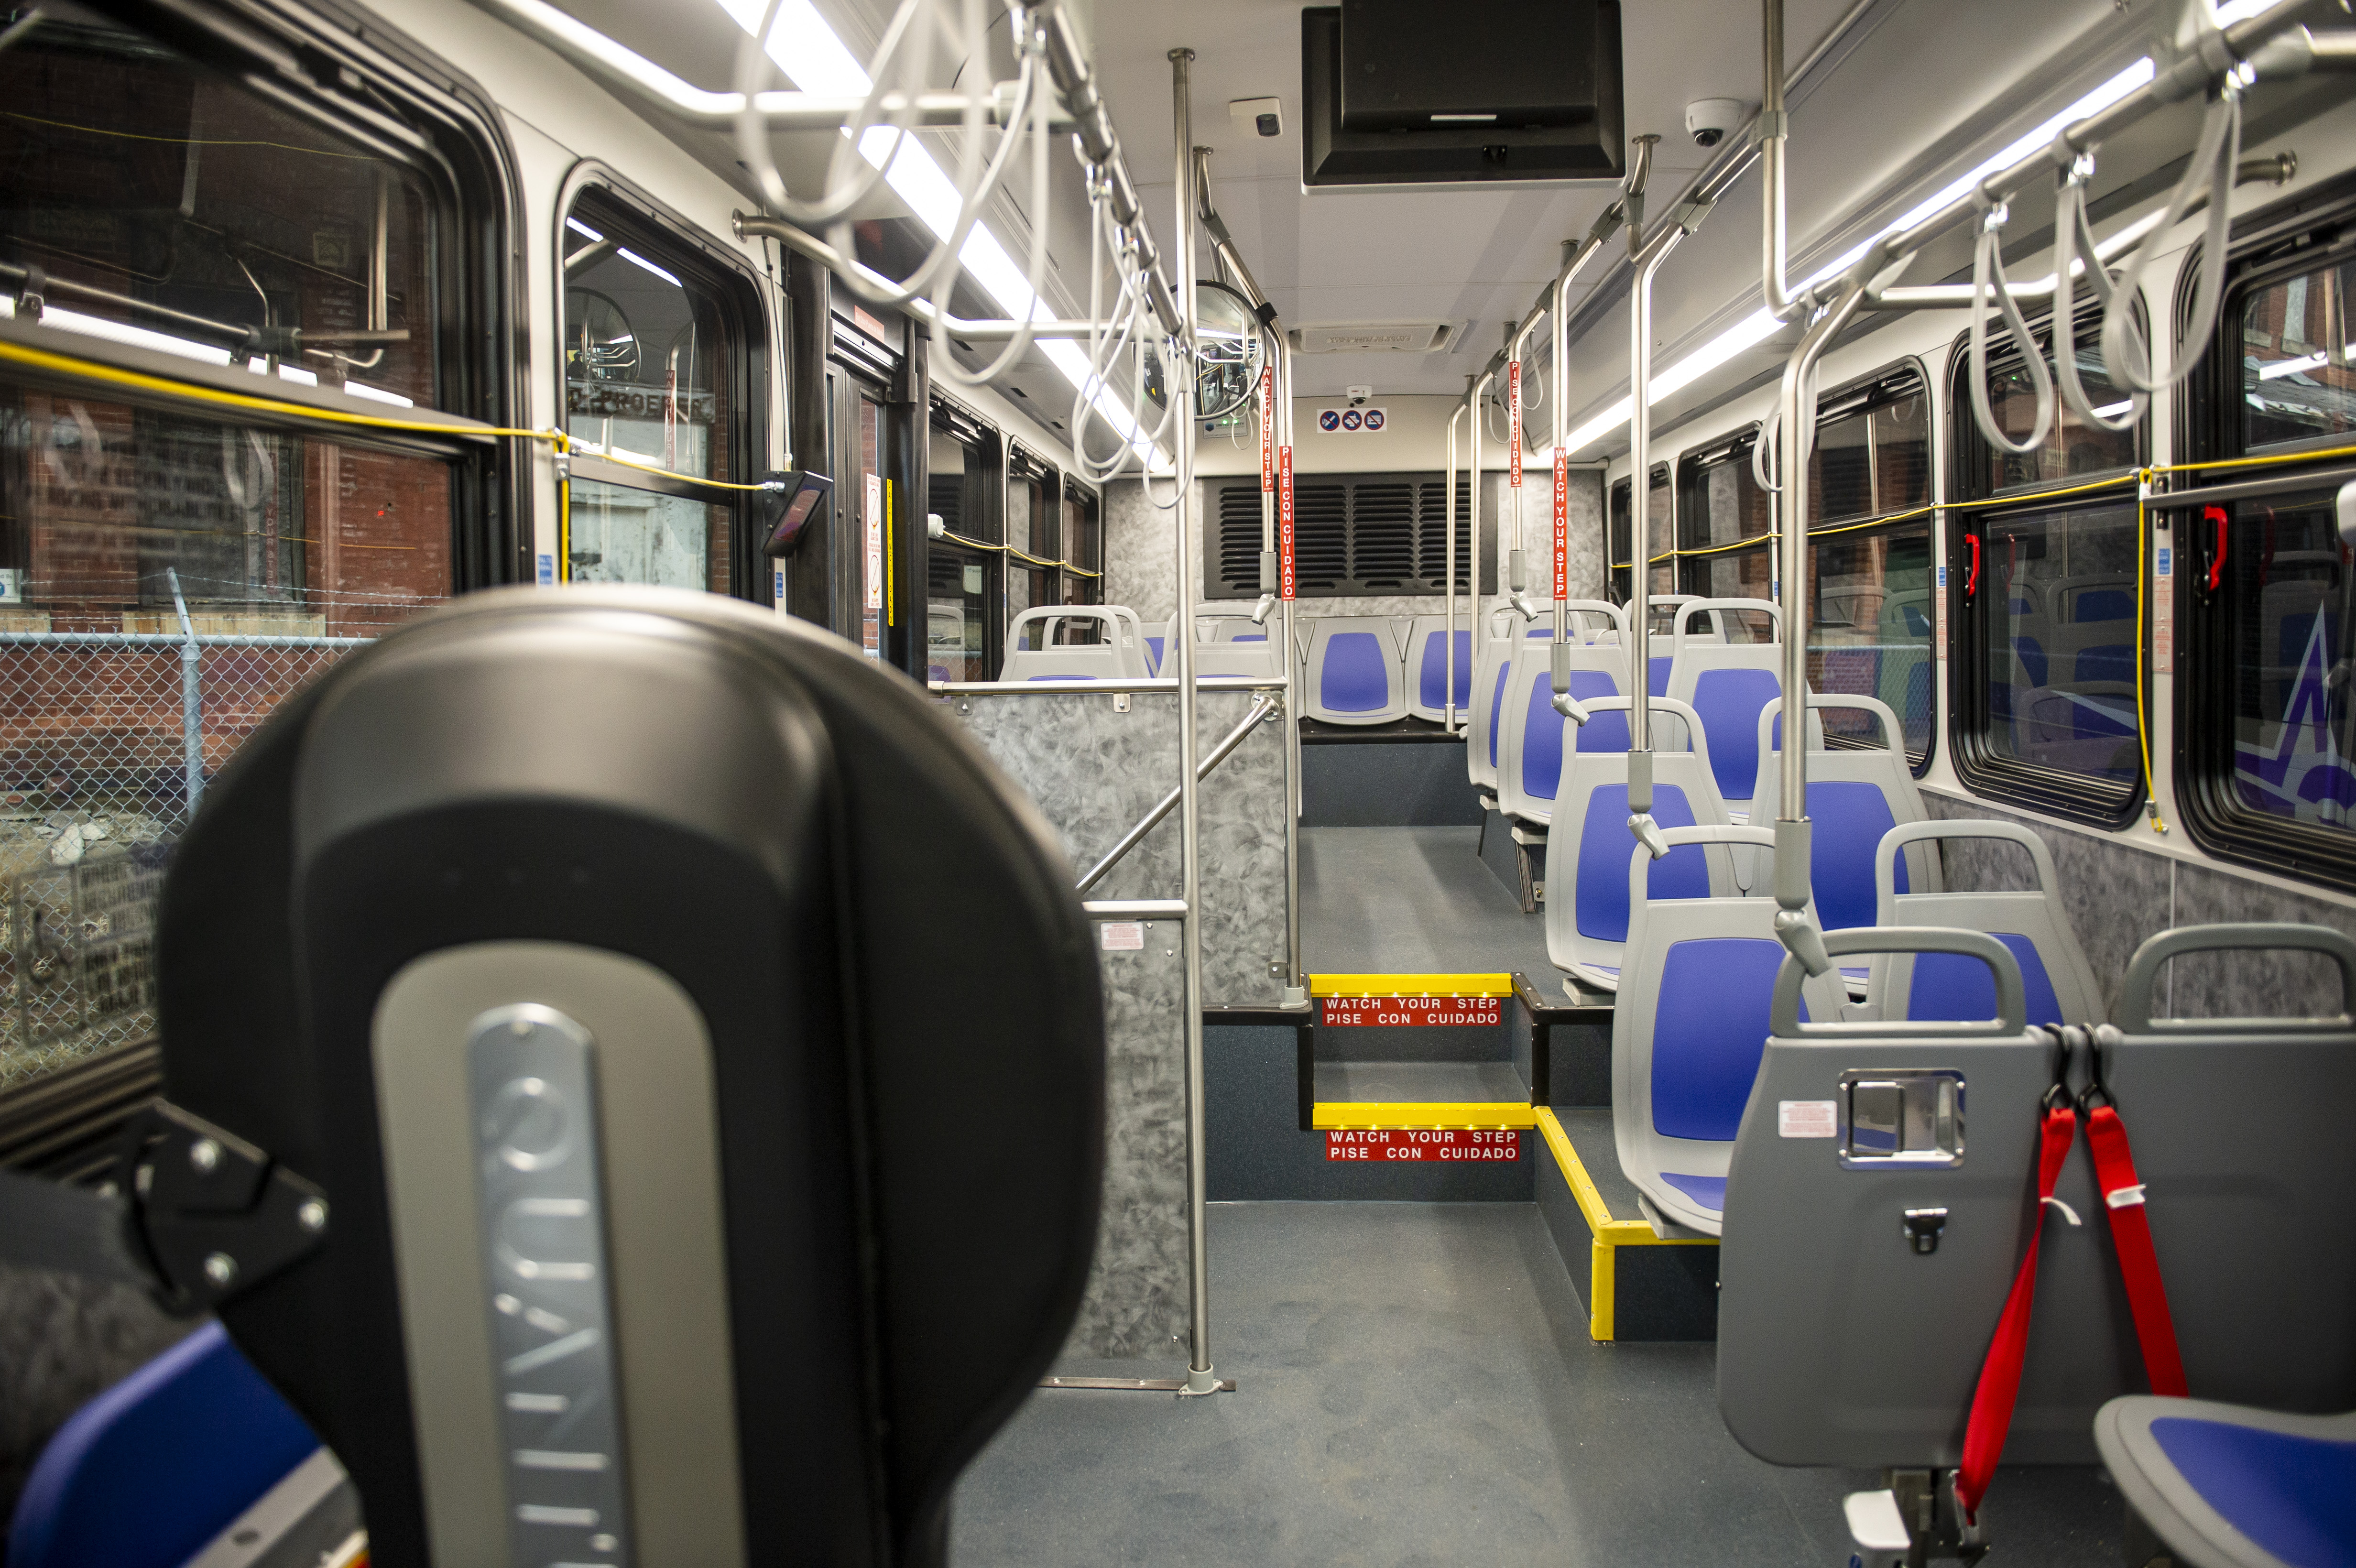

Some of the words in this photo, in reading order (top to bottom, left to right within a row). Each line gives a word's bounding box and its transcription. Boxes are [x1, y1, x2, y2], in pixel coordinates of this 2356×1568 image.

[1263, 369, 1271, 411] WATCH
[1555, 449, 1566, 502] WATCH
[1282, 491, 1291, 521] CON
[1556, 507, 1565, 548] YOUR
[1283, 524, 1293, 596] CUIDADO
[1556, 552, 1564, 594] STEP
[1326, 998, 1381, 1009] WATCH
[1397, 998, 1441, 1009] YOUR
[1457, 998, 1498, 1009] STEP
[1326, 1013, 1362, 1024] PISE
[1378, 1013, 1410, 1024] CON
[1427, 1013, 1498, 1024] CUIDADO
[1330, 1131, 1389, 1143] WATCH
[1407, 1131, 1455, 1143] YOUR
[1472, 1131, 1516, 1143] STEP
[1331, 1147, 1369, 1159] PISE
[1386, 1147, 1421, 1159] CON
[1440, 1147, 1516, 1159] CUIDADO
